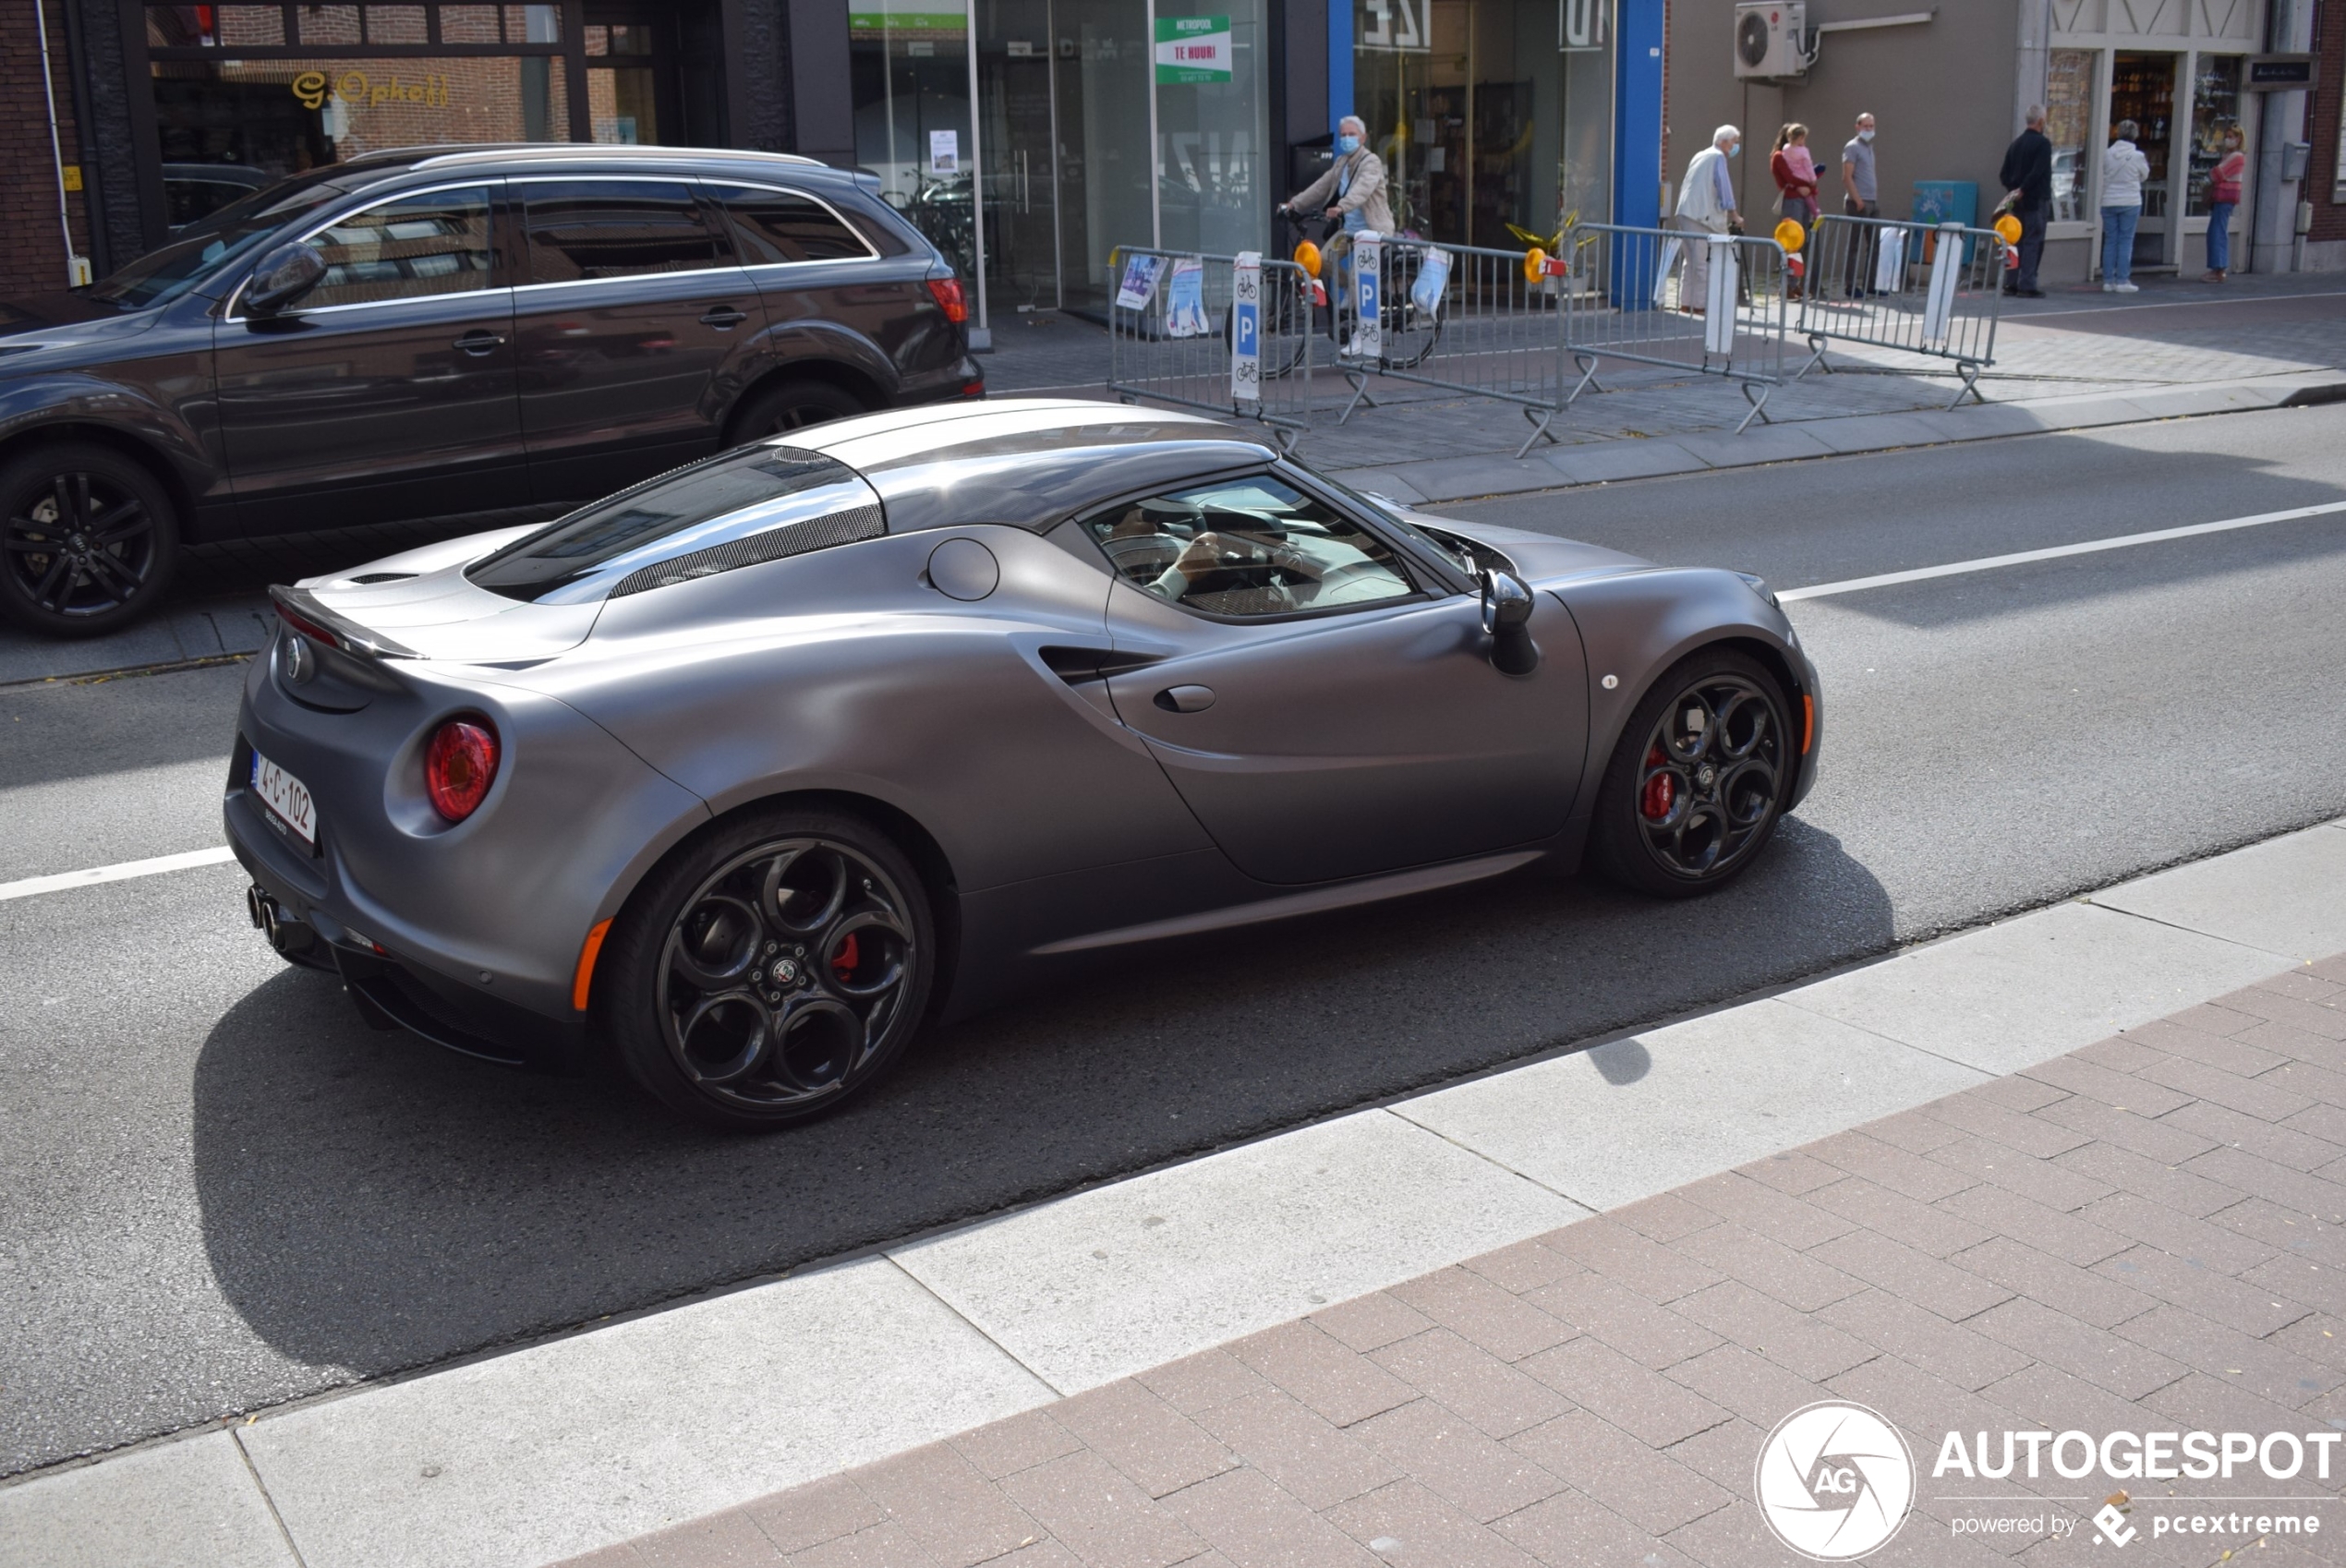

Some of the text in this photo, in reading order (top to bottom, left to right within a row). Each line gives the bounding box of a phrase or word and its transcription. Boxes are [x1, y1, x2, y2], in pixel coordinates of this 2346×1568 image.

[1176, 18, 1213, 31] METROPOOL
[1175, 46, 1185, 60] TE
[1361, 283, 1373, 308] P
[1241, 316, 1253, 344] P
